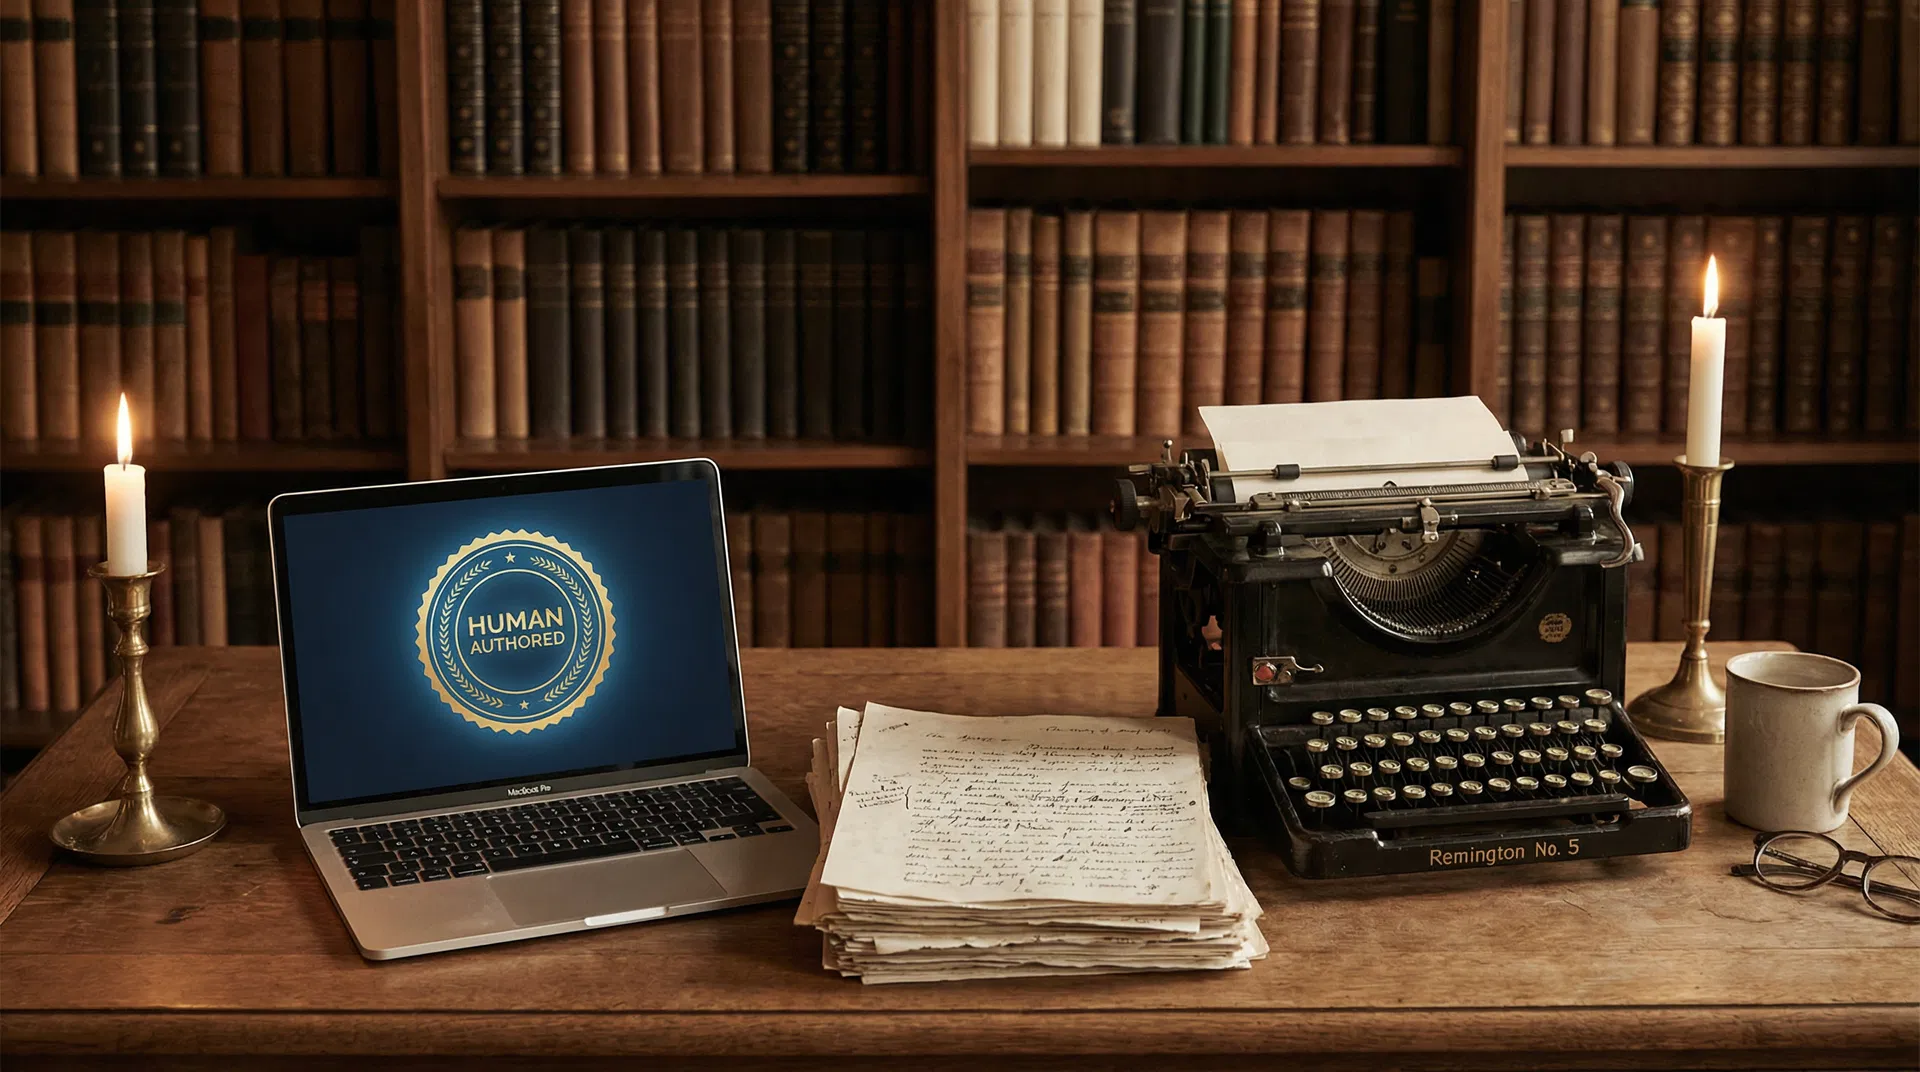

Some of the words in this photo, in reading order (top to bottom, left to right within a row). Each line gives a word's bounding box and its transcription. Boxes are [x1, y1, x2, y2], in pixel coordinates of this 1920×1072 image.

[467, 606, 564, 637] HUMAN
[469, 630, 566, 655] AUTHORED
[1430, 846, 1525, 866] Remington
[1535, 841, 1561, 858] No.
[1567, 838, 1580, 855] 5
